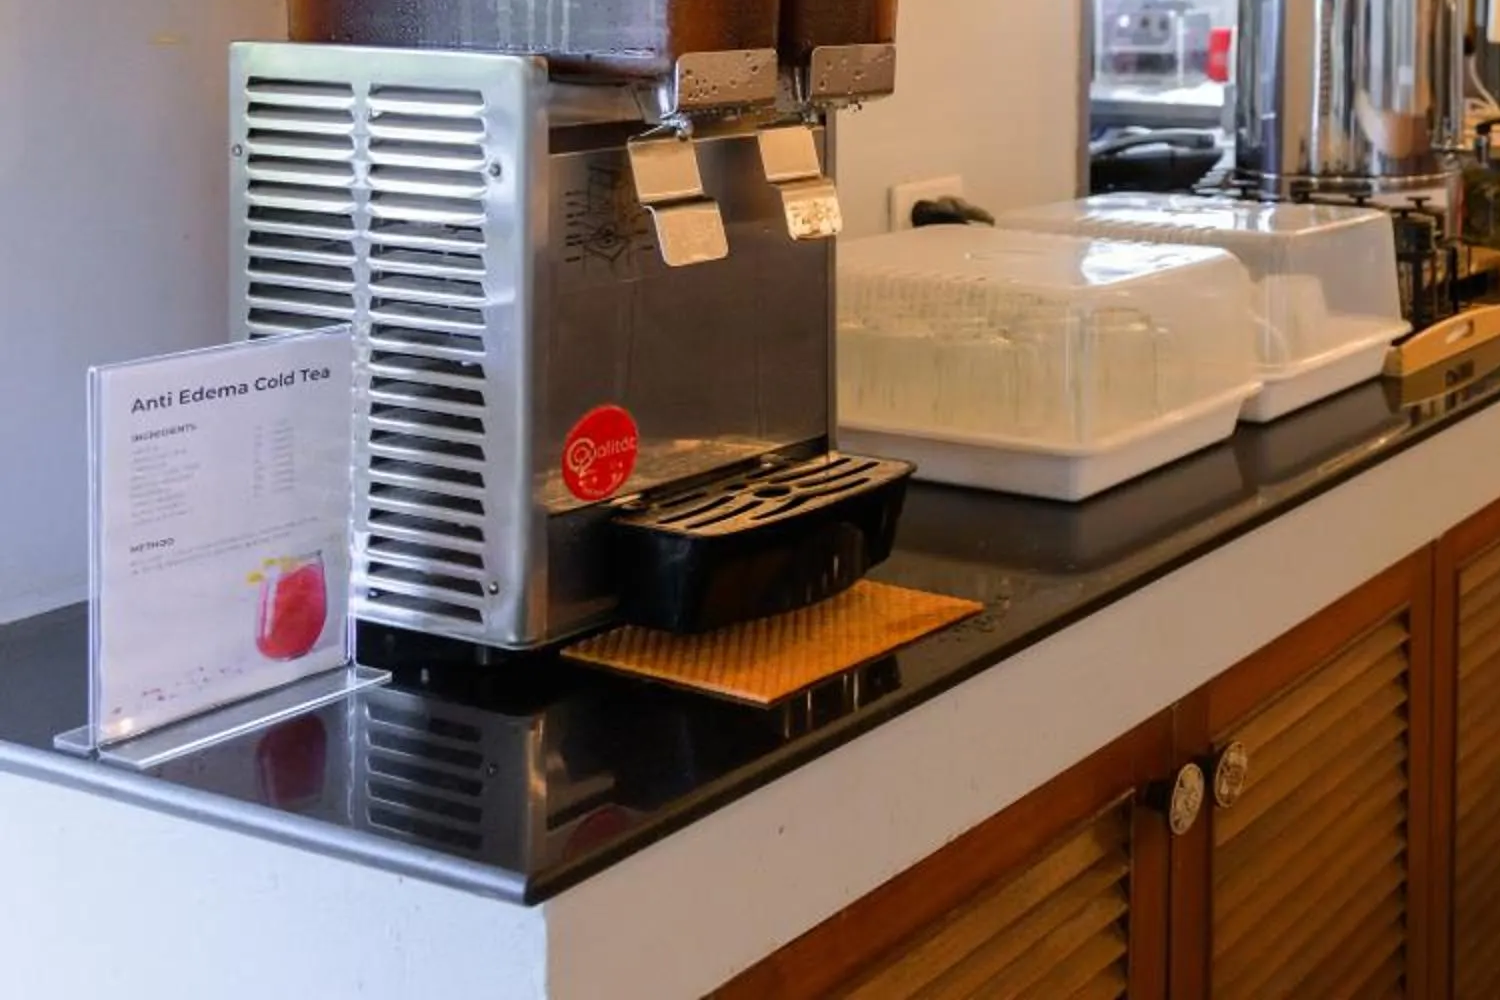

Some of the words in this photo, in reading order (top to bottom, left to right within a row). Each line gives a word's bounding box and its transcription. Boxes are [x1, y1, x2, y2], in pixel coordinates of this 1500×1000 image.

[131, 391, 173, 414] Anti
[179, 382, 249, 406] Edema
[254, 371, 295, 392] Cold
[300, 366, 331, 384] Tea
